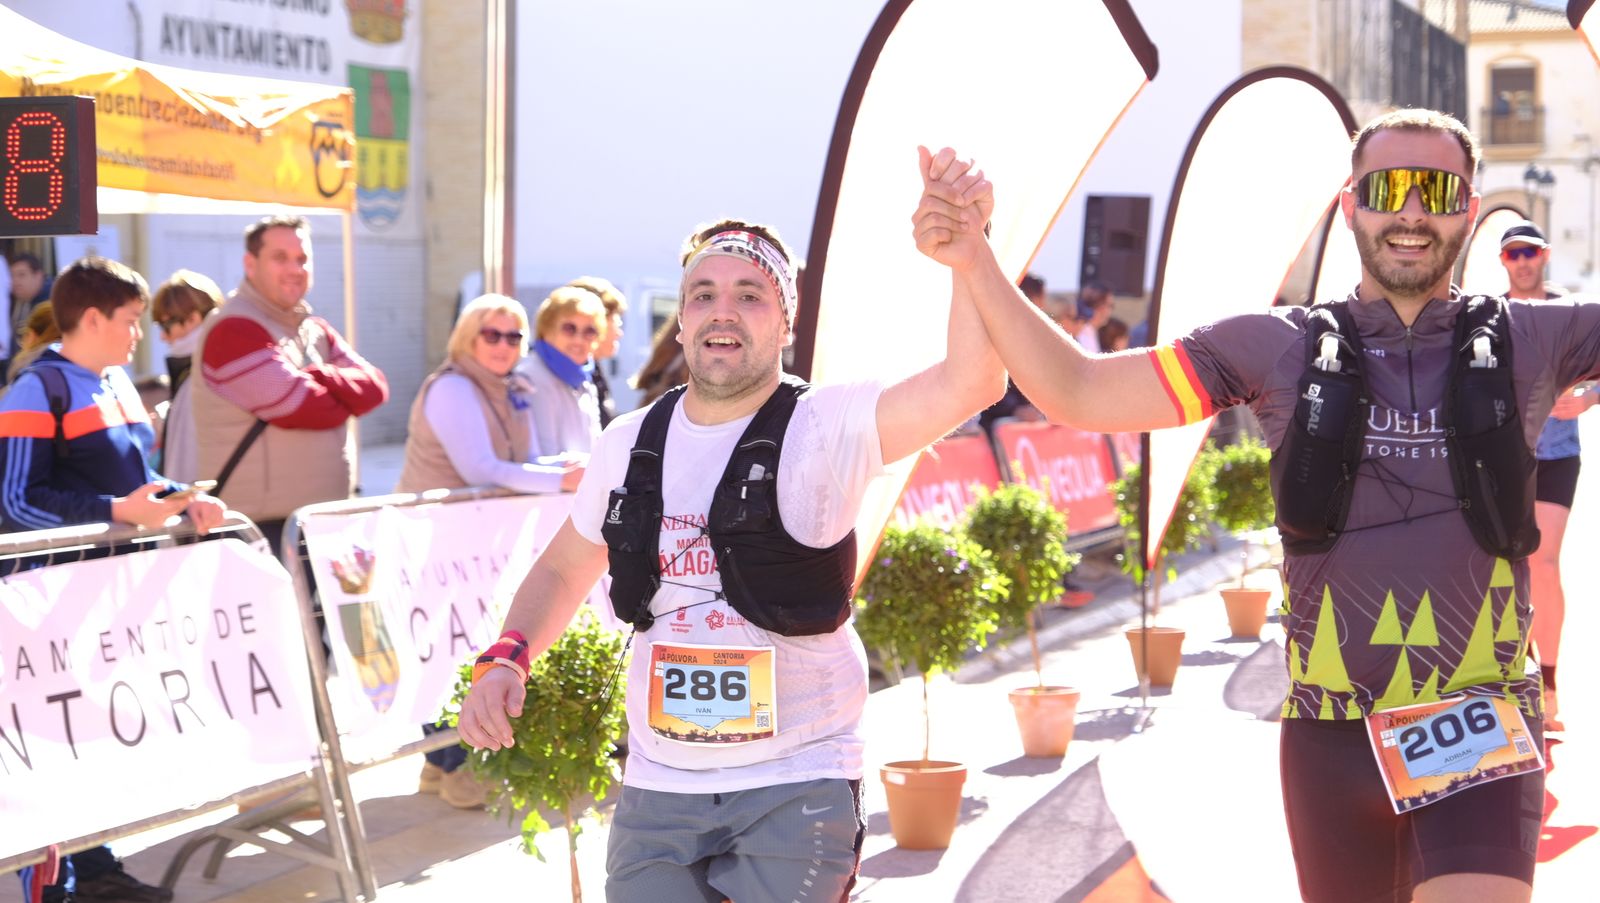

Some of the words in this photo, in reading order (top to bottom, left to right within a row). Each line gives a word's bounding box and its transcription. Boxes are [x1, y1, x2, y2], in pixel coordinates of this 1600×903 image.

[160, 14, 333, 75] AYUNTAMIENTO
[5, 111, 66, 221] 8
[214, 602, 257, 640] DE
[713, 652, 745, 660] CANTORIA
[665, 667, 747, 701] 286
[1399, 701, 1497, 763] 206
